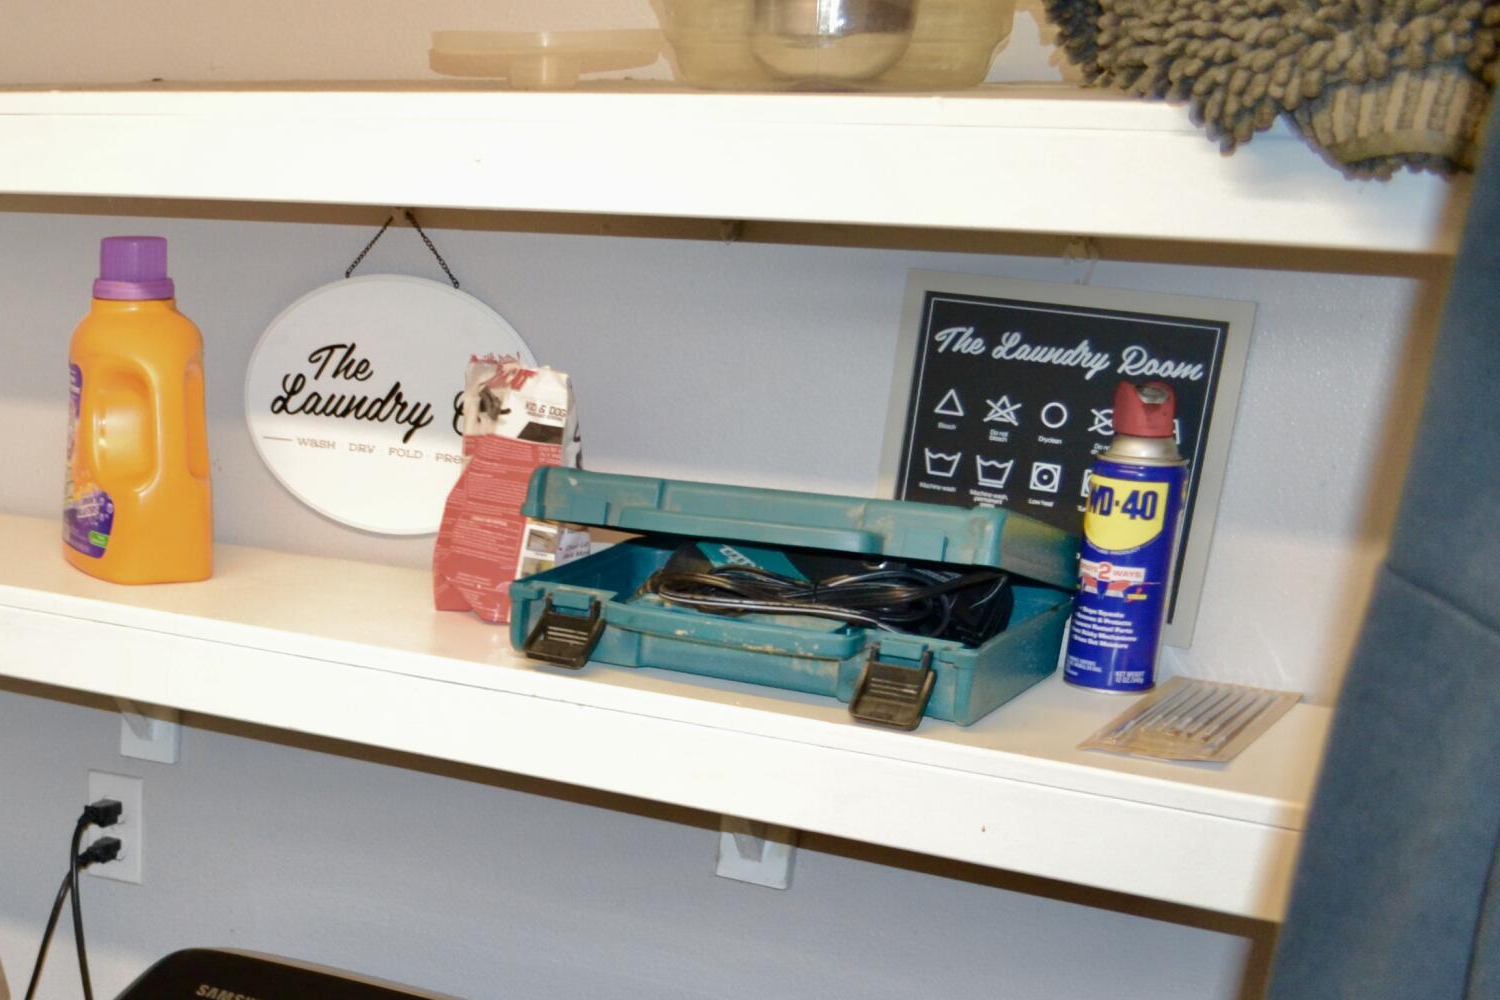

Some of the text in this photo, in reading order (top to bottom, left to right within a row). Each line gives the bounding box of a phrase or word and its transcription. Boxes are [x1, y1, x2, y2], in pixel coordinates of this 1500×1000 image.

[308, 342, 374, 381] The
[934, 326, 1205, 382] The Laundry Room
[270, 372, 434, 444] Laundry
[349, 442, 376, 455] DRY
[388, 447, 424, 460] FOLD
[1099, 562, 1112, 580] 2
[1113, 569, 1141, 579] WAYS
